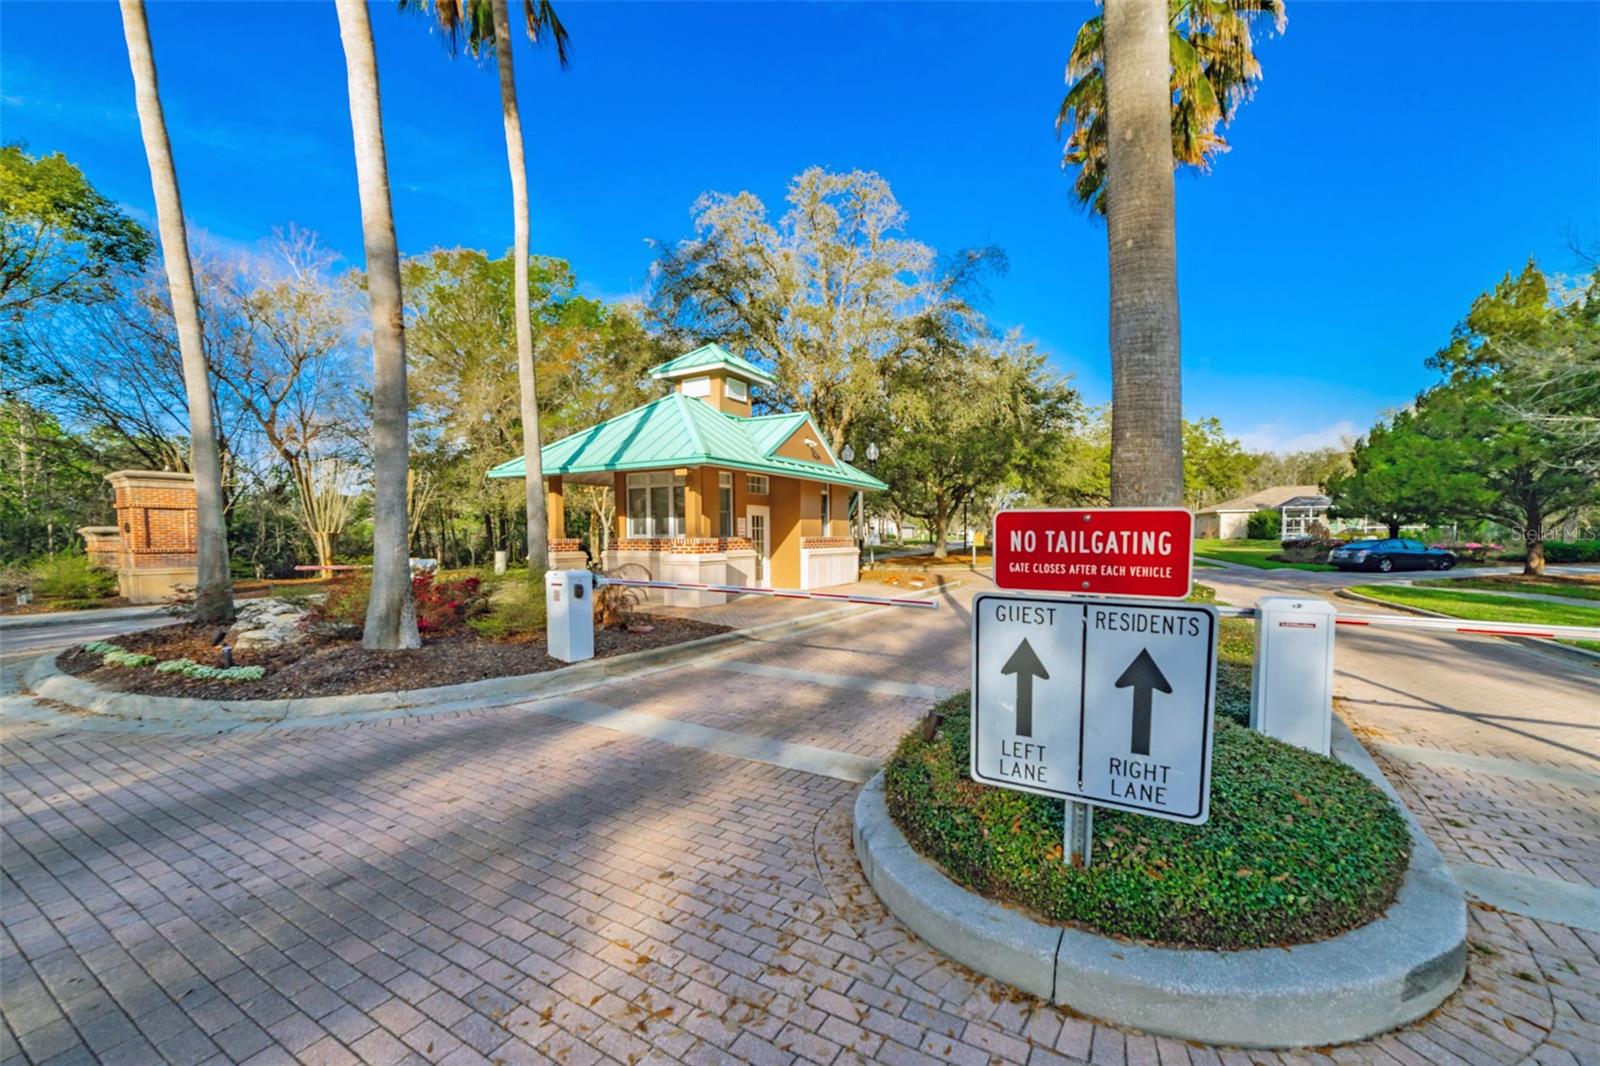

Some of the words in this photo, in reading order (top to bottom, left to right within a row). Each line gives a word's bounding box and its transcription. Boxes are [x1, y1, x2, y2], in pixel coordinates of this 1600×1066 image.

[1009, 530, 1037, 553] NO
[1045, 530, 1173, 556] TAILGATING
[1009, 562, 1030, 574] GATE
[1033, 563, 1066, 575] CLOSES
[1069, 564, 1097, 576] AFTER
[1100, 565, 1126, 577] EACH
[1130, 566, 1172, 579] VEHICLE
[995, 605, 1057, 626] GUEST
[1095, 611, 1200, 637] RESIDENTS
[1001, 739, 1047, 762] LEFT
[999, 759, 1048, 783] LANE
[1108, 757, 1171, 784] RIGHT
[1110, 780, 1167, 805] LANE
